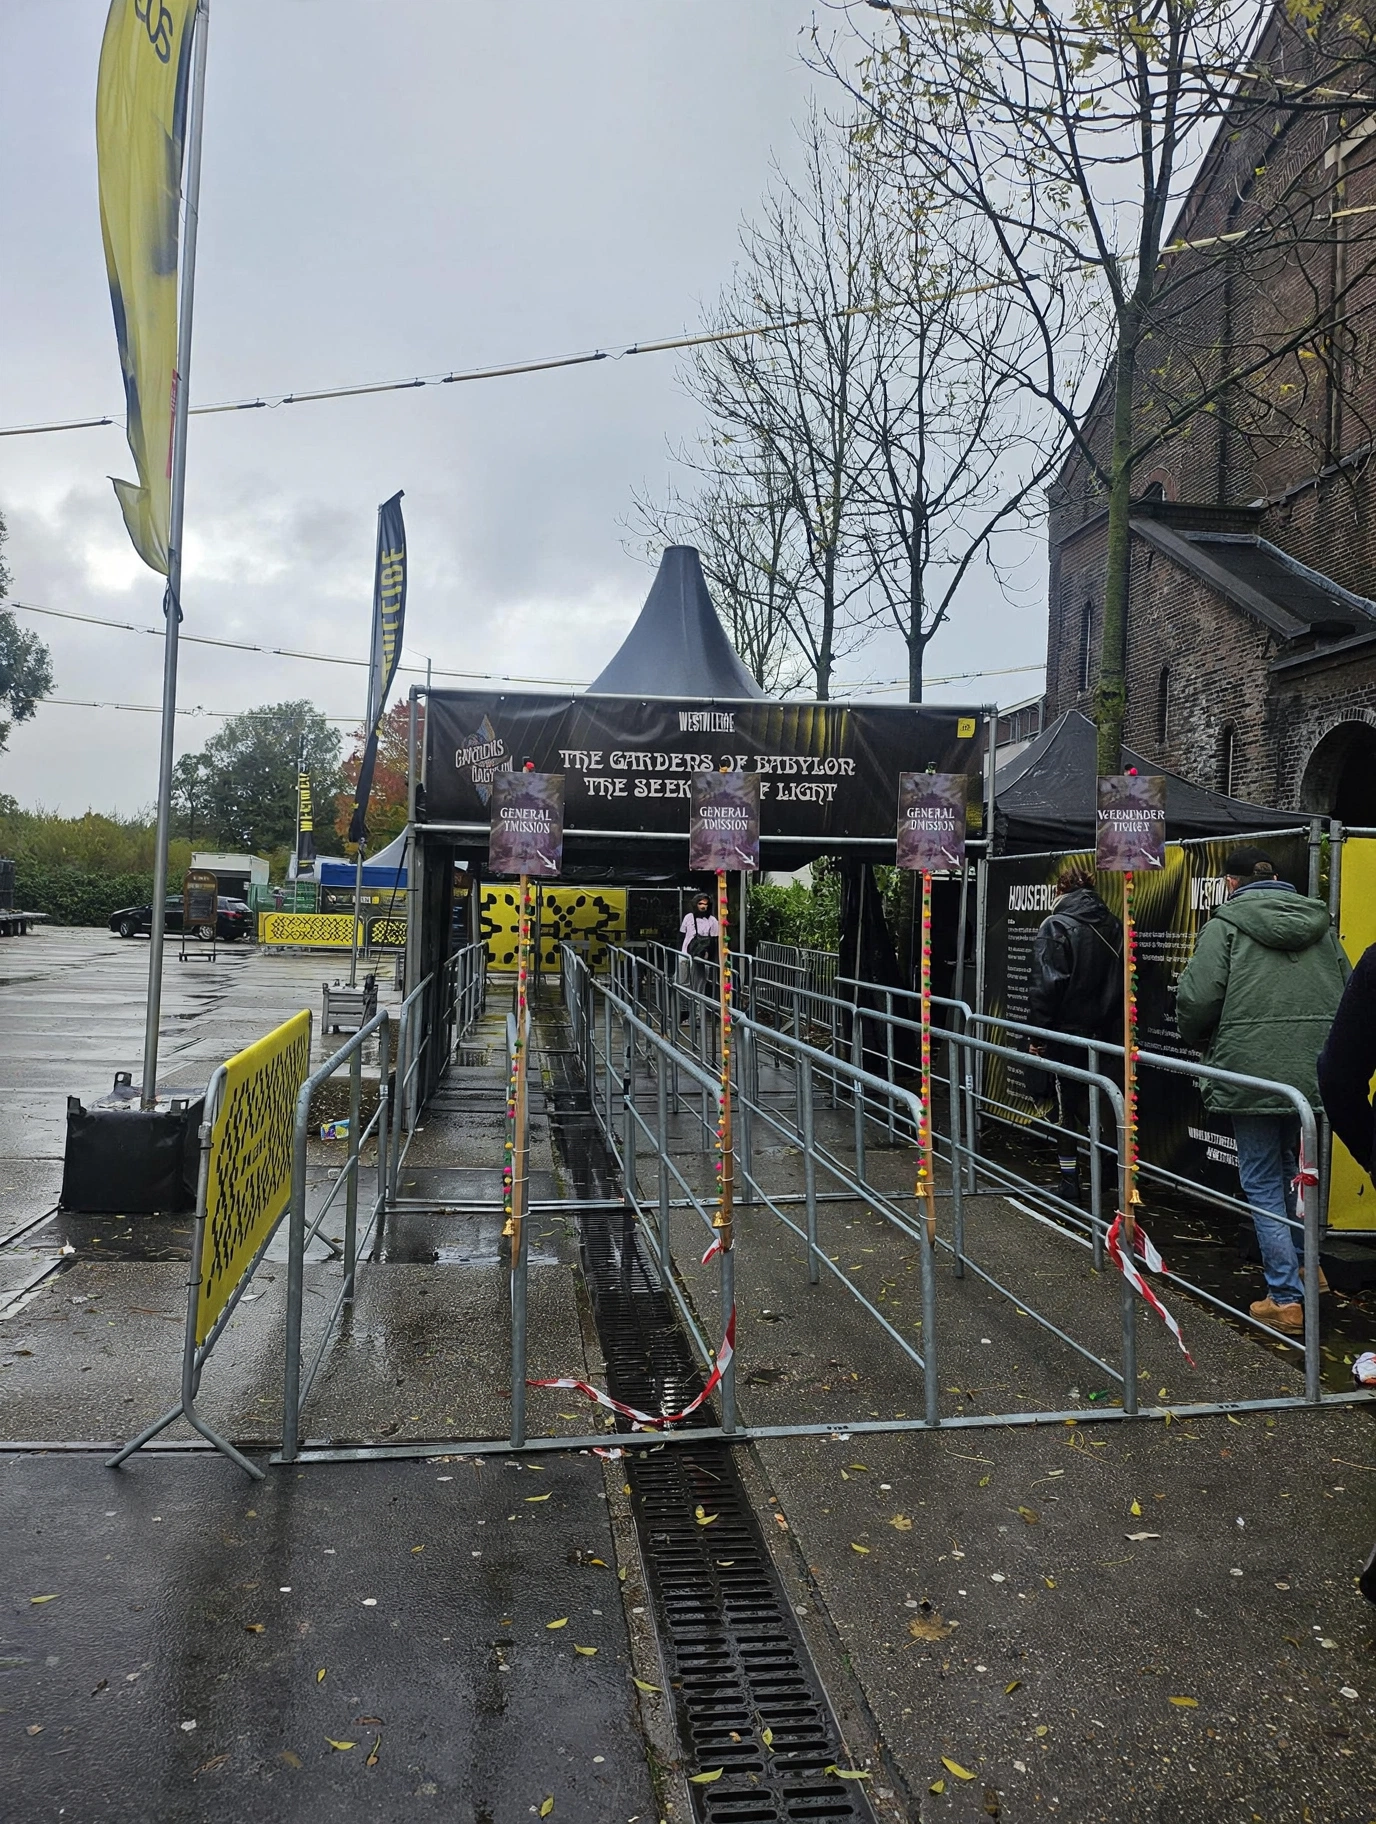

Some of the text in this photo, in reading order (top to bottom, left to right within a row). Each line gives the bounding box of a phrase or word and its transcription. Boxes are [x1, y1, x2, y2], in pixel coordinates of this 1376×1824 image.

[558, 749, 604, 773] THE
[609, 751, 714, 772] GARDENS
[753, 754, 857, 776] BABYLON
[583, 777, 628, 800] THE
[633, 779, 692, 798] SEEK
[775, 782, 838, 805] LIGHT
[500, 807, 552, 821] GENERAL
[699, 806, 749, 818] GENERAL
[906, 807, 955, 819] GENERAL
